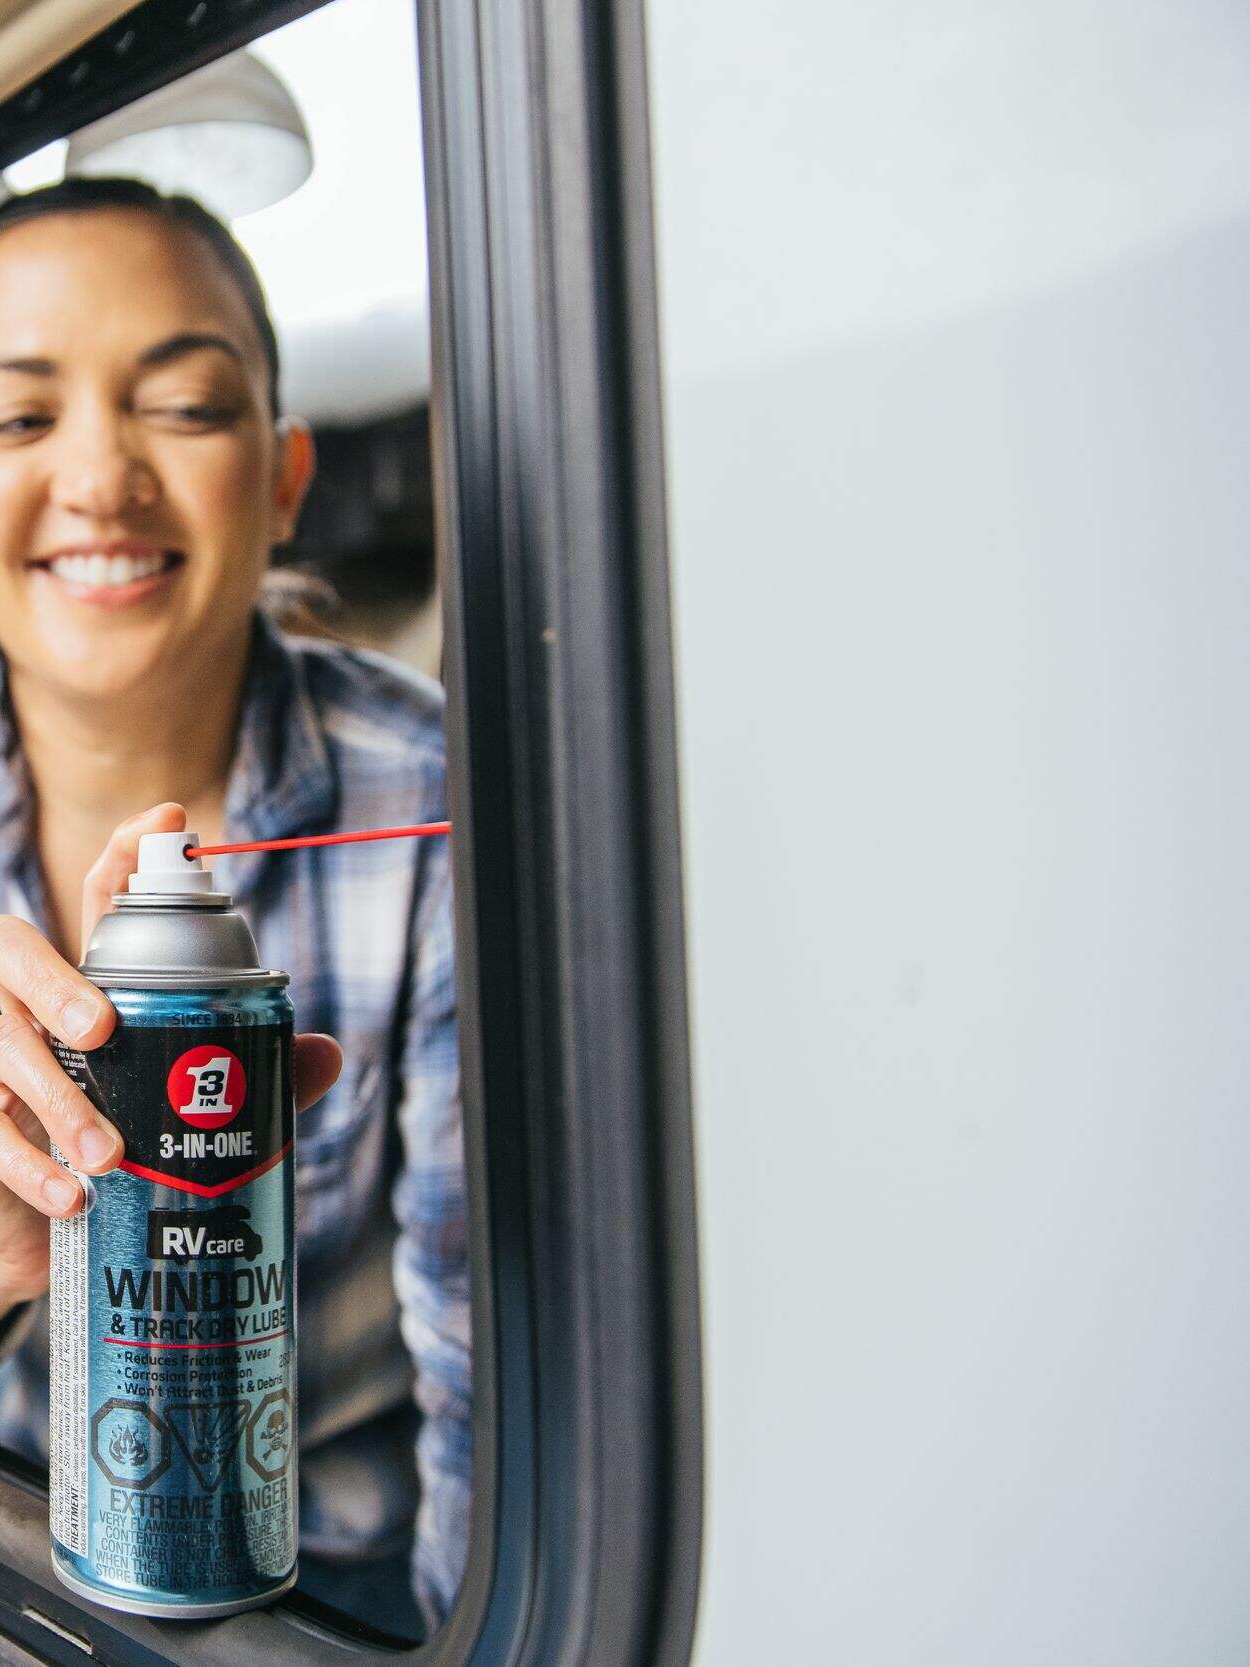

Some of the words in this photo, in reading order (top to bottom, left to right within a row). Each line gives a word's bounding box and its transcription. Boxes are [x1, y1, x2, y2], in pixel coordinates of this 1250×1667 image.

[173, 1013, 212, 1025] SINCE
[197, 1069, 225, 1096] 3
[199, 1098, 218, 1107] IN
[159, 1131, 253, 1159] 3-IN-ONE
[104, 1260, 287, 1312] WINDOW
[111, 1313, 126, 1336] &
[130, 1315, 200, 1340] TRACK
[209, 1315, 249, 1339] DRY
[252, 1306, 287, 1335] LUBE
[124, 1350, 179, 1366] Reduces
[181, 1353, 231, 1367] Friction
[245, 1348, 271, 1362] Wear
[124, 1367, 186, 1382] Corrosion
[124, 1382, 162, 1397] Won't
[246, 1380, 255, 1393] &
[256, 1374, 284, 1391] Debris
[110, 1488, 214, 1519] EXTREME
[221, 1478, 288, 1518] DANGER
[99, 1509, 128, 1528] VERY
[101, 1537, 167, 1562] CONTAINER
[106, 1525, 168, 1549] CONTENTS
[172, 1533, 214, 1549] UNDER
[96, 1548, 129, 1569] WHEN
[132, 1558, 157, 1574] THE
[95, 1563, 131, 1584] STORE
[134, 1572, 167, 1589] TUBE
